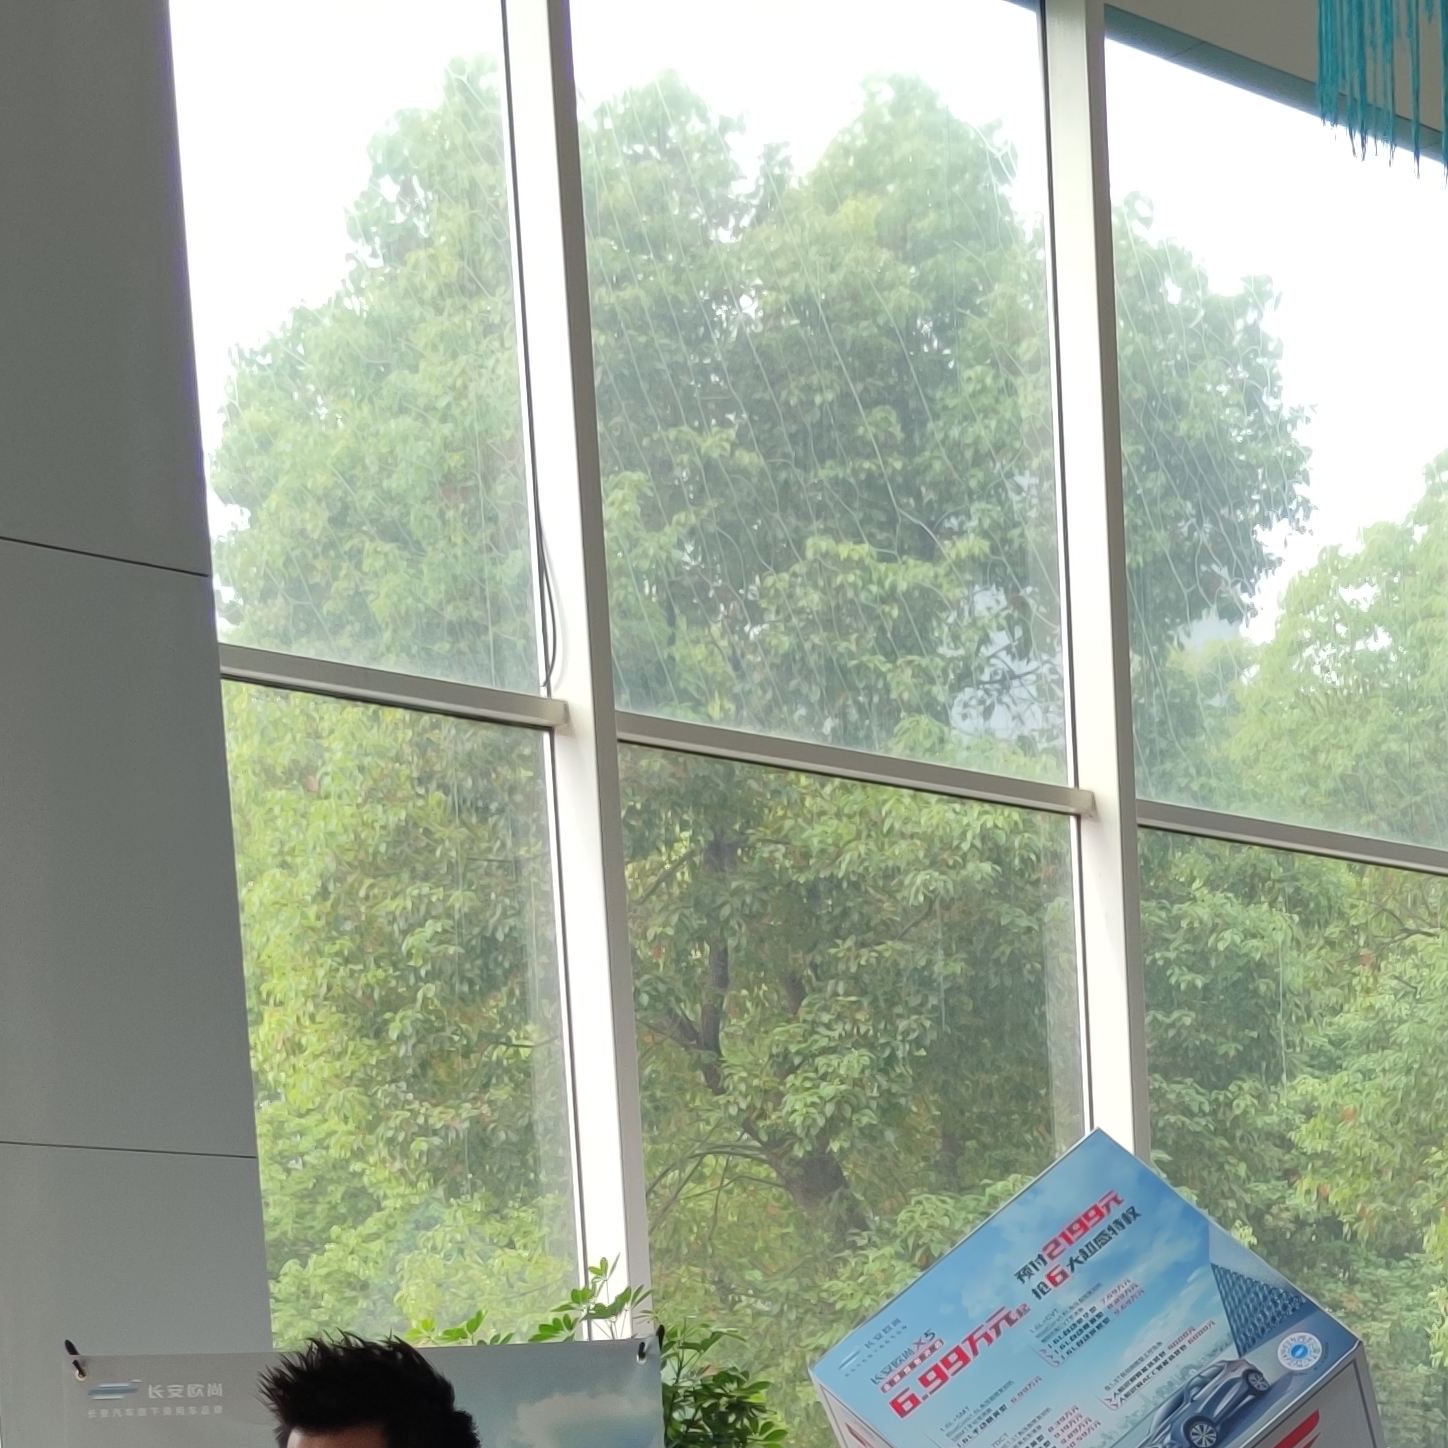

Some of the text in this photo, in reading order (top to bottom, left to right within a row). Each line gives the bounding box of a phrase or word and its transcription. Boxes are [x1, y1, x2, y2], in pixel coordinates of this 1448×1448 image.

[1010, 1188, 1125, 1285] 预付2199元
[147, 1382, 223, 1399] 长安欧尚
[885, 1293, 1032, 1419] 6.99万元起
